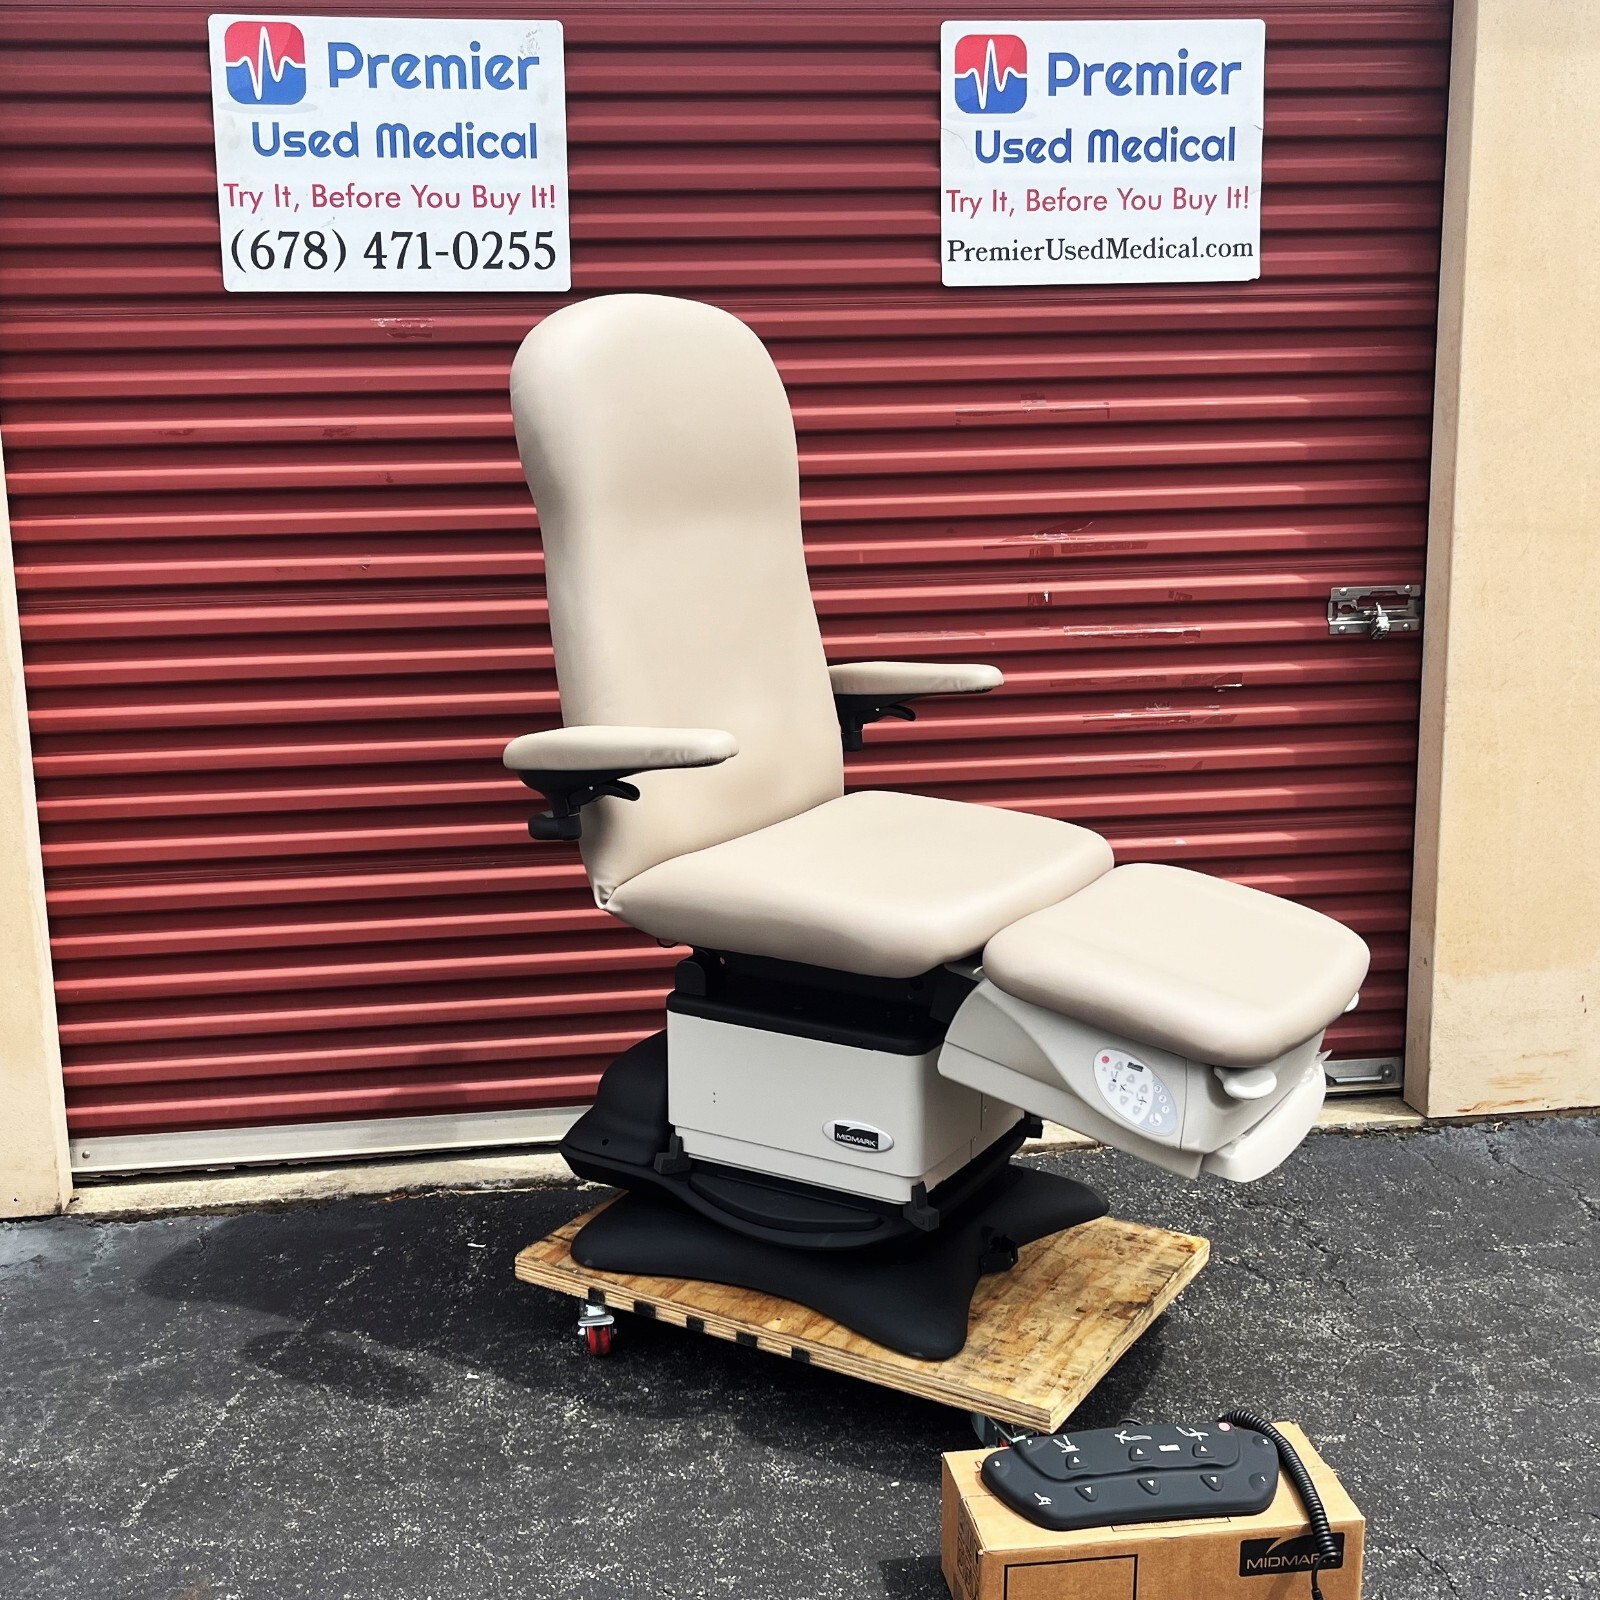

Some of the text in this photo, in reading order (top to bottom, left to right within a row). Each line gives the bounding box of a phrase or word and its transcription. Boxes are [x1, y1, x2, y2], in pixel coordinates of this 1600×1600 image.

[328, 41, 540, 90] Premier
[1048, 48, 1241, 96] Premier
[252, 122, 537, 159] Used Medical
[975, 126, 1235, 164] Used Medical
[223, 183, 556, 215] Try It, Before You Buy It!
[946, 186, 1249, 219] Try It, Before You Buy It!
[231, 229, 556, 273] (678) 471-0255
[947, 237, 1253, 262] PremierUsedMedical.com
[836, 1132, 876, 1147] MIDMARK
